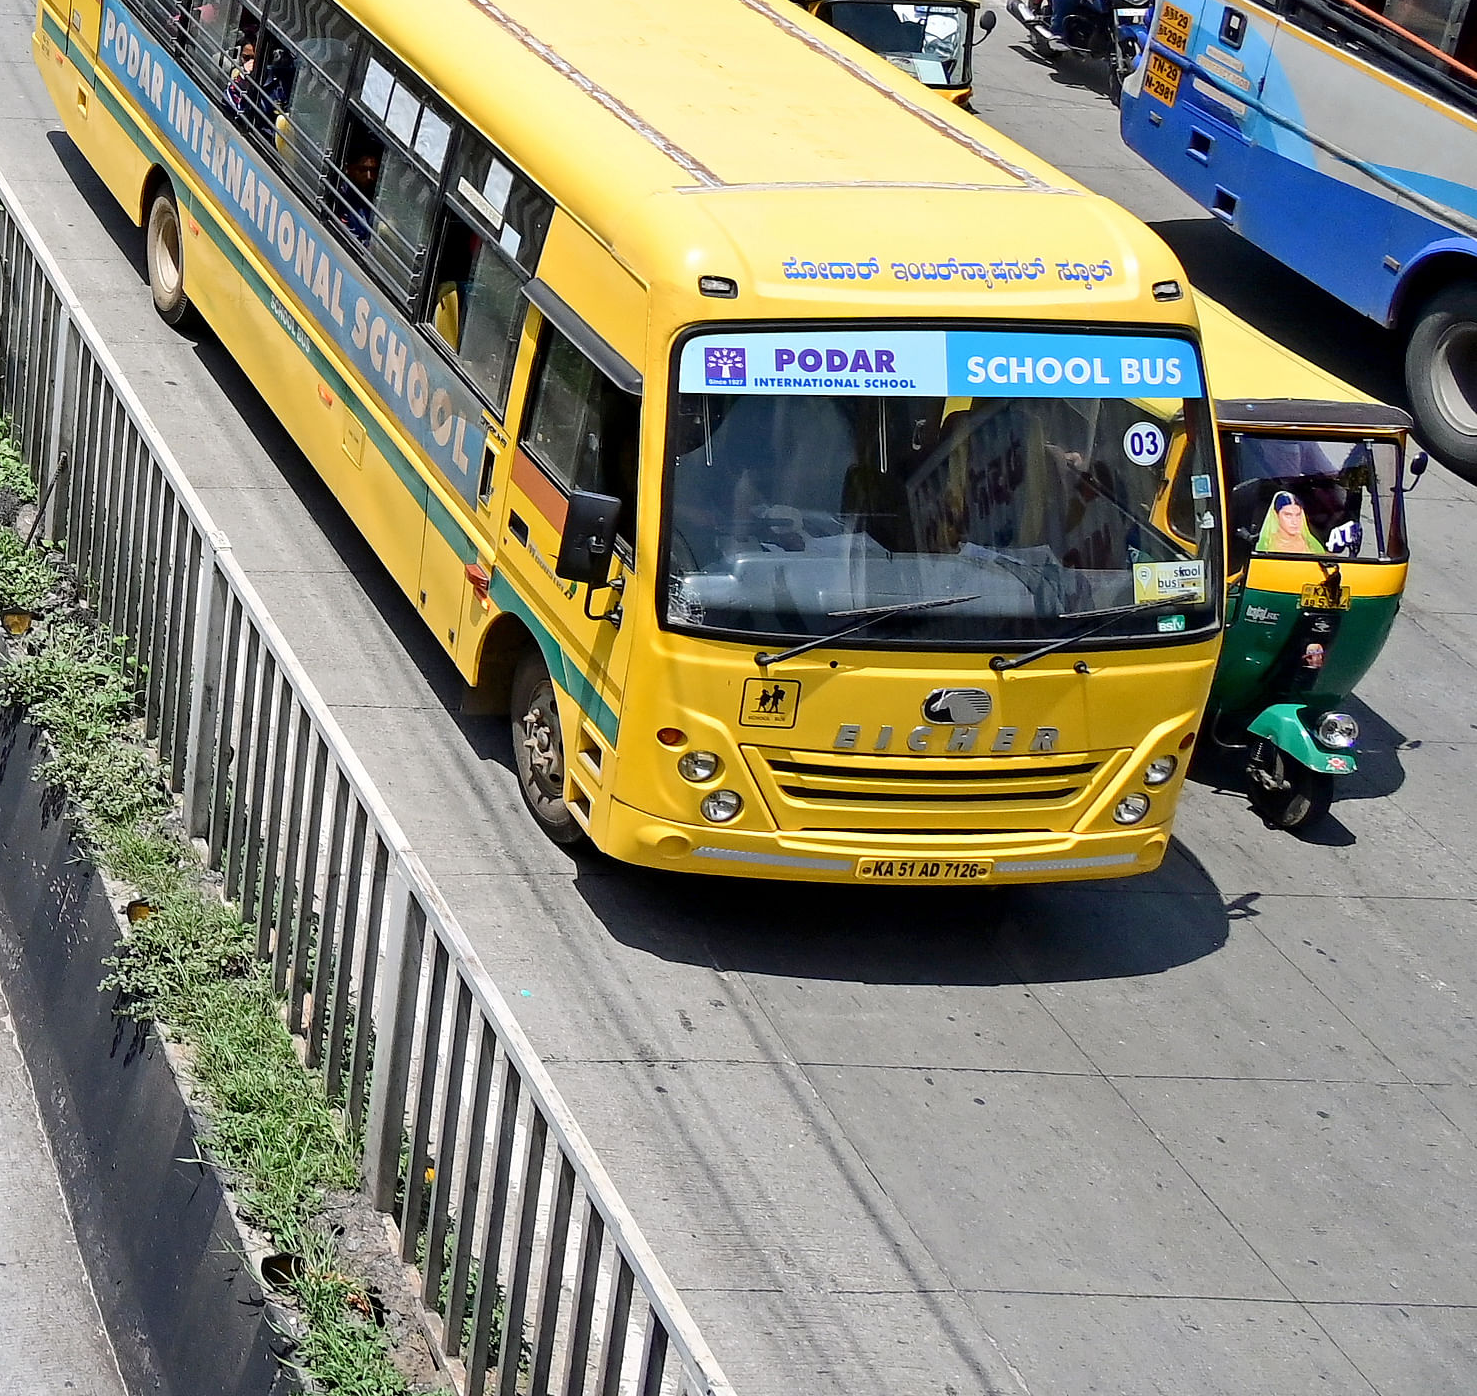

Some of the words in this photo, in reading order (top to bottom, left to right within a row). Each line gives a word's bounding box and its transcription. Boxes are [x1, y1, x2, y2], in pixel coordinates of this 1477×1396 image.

[1152, 56, 1178, 82] TN-29
[1145, 74, 1175, 105] N-2981
[104, 6, 165, 117] PODAR
[168, 81, 345, 329] INTERNATIONAL
[351, 295, 470, 476] SCHOOL
[782, 256, 880, 282] ಪೋದಾರ್
[1056, 258, 1114, 290] ಸ್ಕೂಲ್
[270, 294, 296, 337] SCHOOL
[296, 326, 311, 354] BUS
[775, 348, 897, 373] PODAR
[966, 355, 1111, 385] SCHOOL
[1121, 357, 1182, 386] BUS
[708, 378, 728, 386] Since
[728, 378, 744, 386] 1927
[754, 377, 860, 389] INTERNATIONAL
[864, 379, 917, 389] SCHOOL
[1130, 431, 1159, 457] 03
[1157, 578, 1177, 589] bus
[748, 714, 770, 722] SCHOOL
[833, 723, 1060, 752] EICHER
[872, 861, 894, 876] KA
[897, 861, 915, 877] 51
[918, 862, 941, 878] AD
[944, 862, 978, 879] 7126
